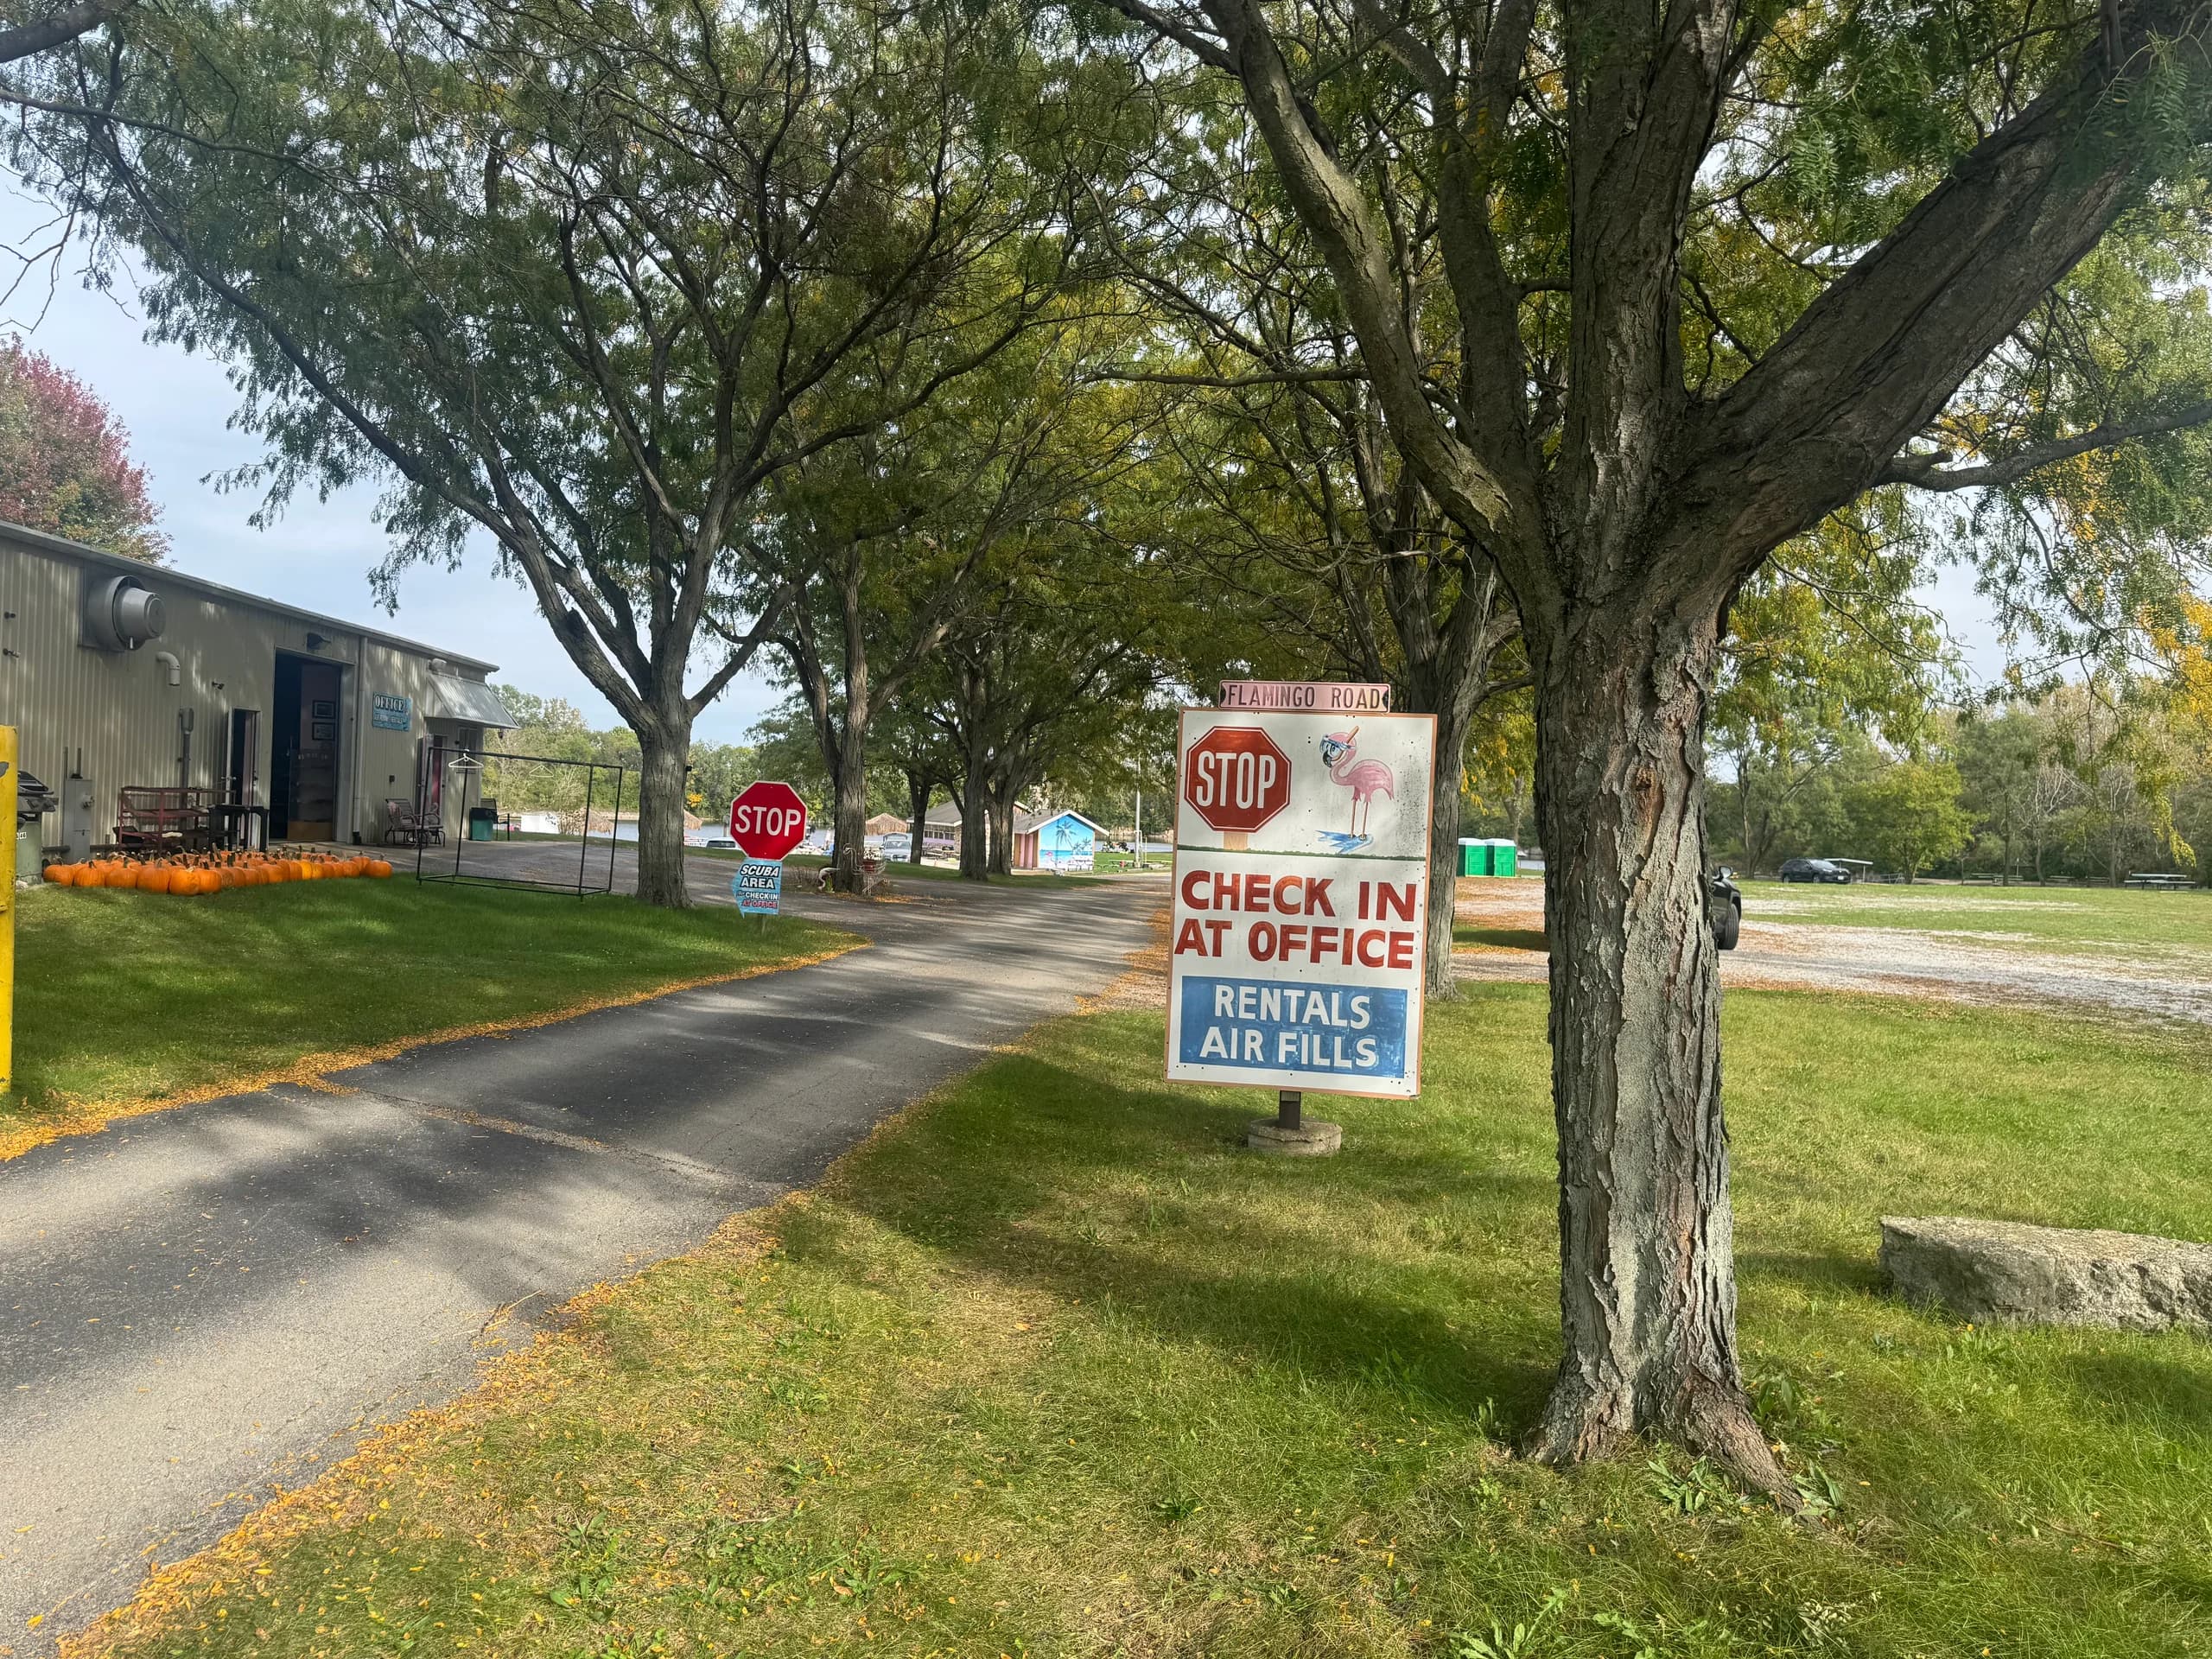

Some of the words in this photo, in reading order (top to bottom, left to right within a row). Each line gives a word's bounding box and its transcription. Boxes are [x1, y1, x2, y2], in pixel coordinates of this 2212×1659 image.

[375, 696, 404, 711] OFFICE
[1228, 684, 1315, 707] FLAMINGO
[1332, 687, 1380, 709] ROAD
[1197, 751, 1276, 809] STOP
[734, 804, 801, 836] STOP
[741, 865, 779, 876] SCUBA
[741, 877, 774, 889] AREA
[1181, 870, 1335, 917] CHECK
[1357, 881, 1416, 922] IN
[1174, 918, 1232, 957] AT
[1248, 921, 1414, 969] OFFICE
[1214, 984, 1370, 1029] RENTALS
[1199, 1027, 1263, 1062] AIR
[1278, 1032, 1377, 1069] FILLS
